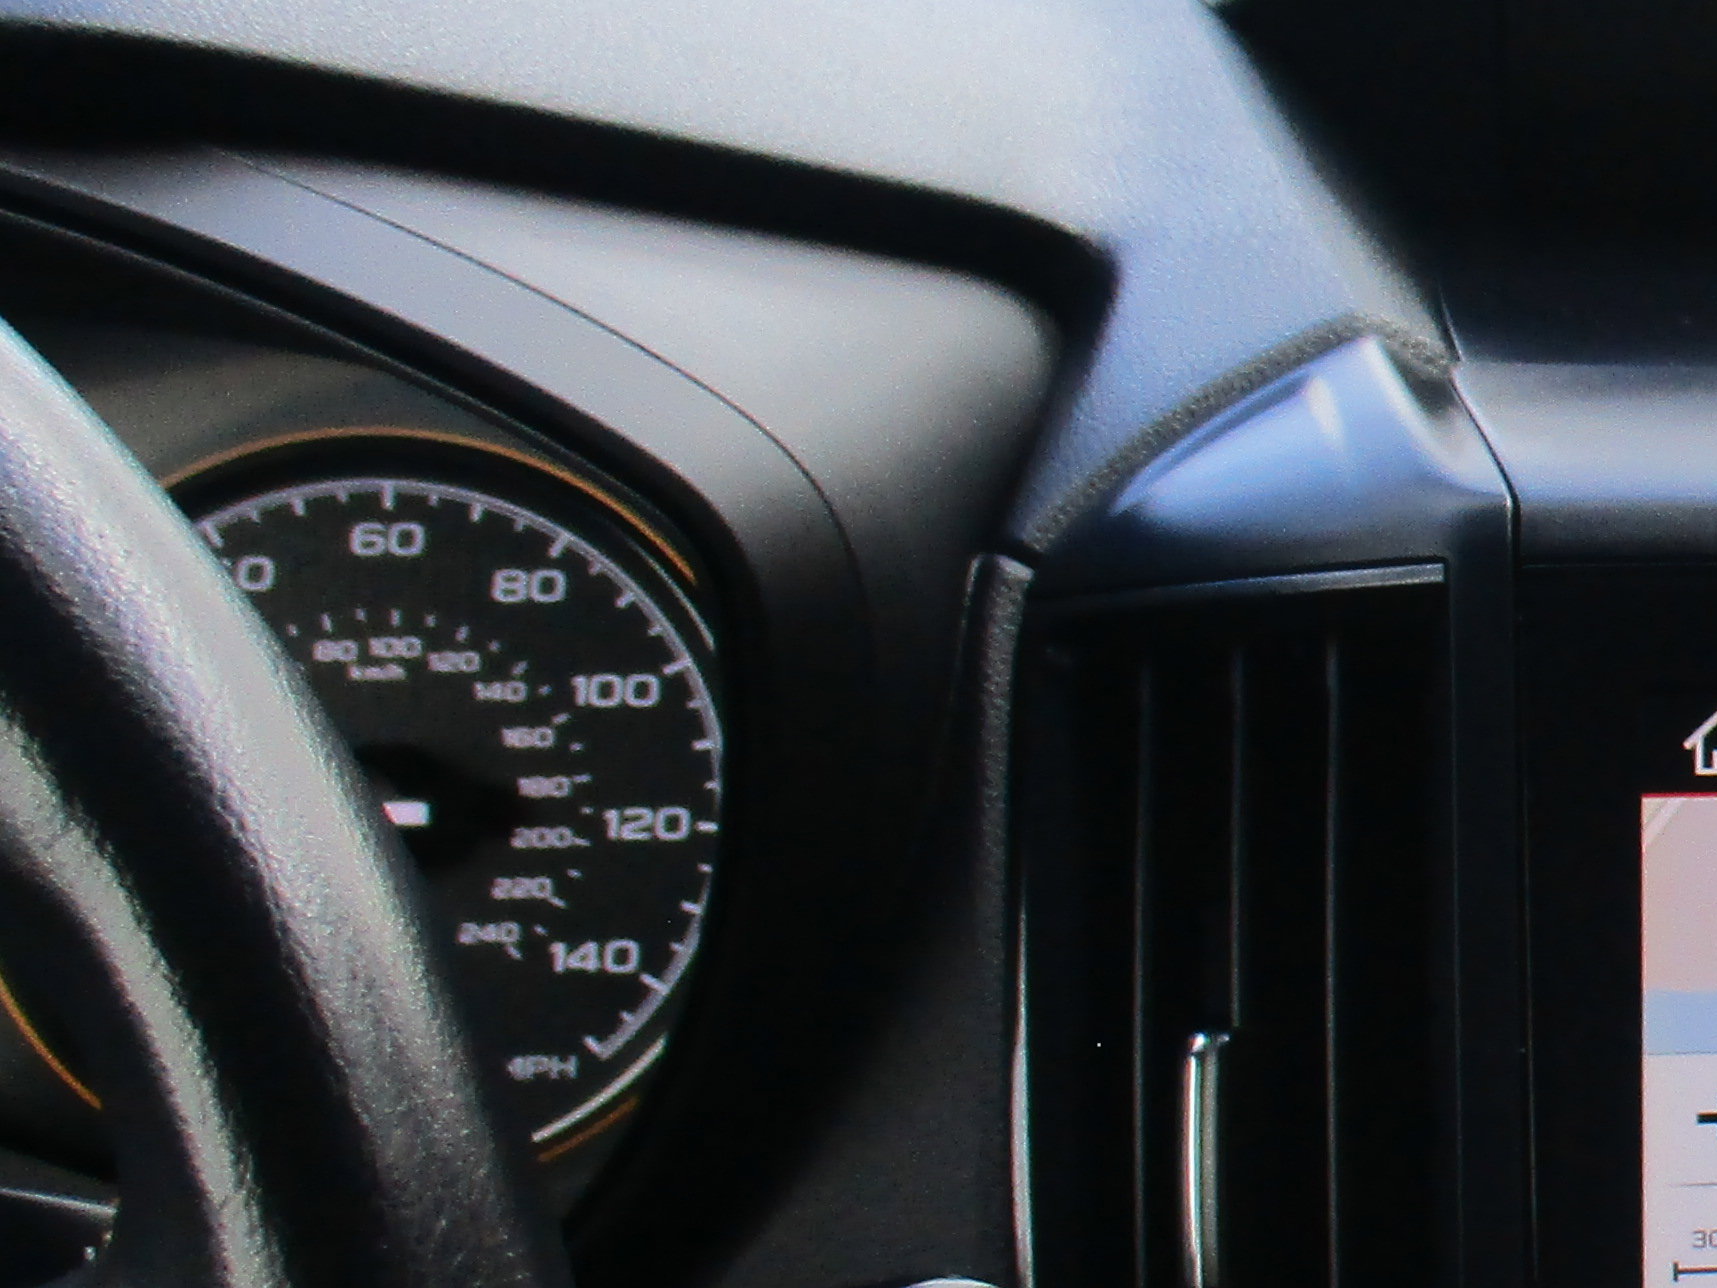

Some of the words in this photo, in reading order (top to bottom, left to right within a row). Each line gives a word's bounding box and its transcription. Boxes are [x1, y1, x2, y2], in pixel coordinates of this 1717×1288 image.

[349, 521, 426, 558] 60
[491, 568, 567, 604] 80
[368, 635, 423, 660] 100
[473, 680, 529, 703] 140
[571, 672, 661, 709] 100
[604, 805, 692, 842] 120
[457, 920, 520, 945] 240
[549, 937, 641, 975] 140
